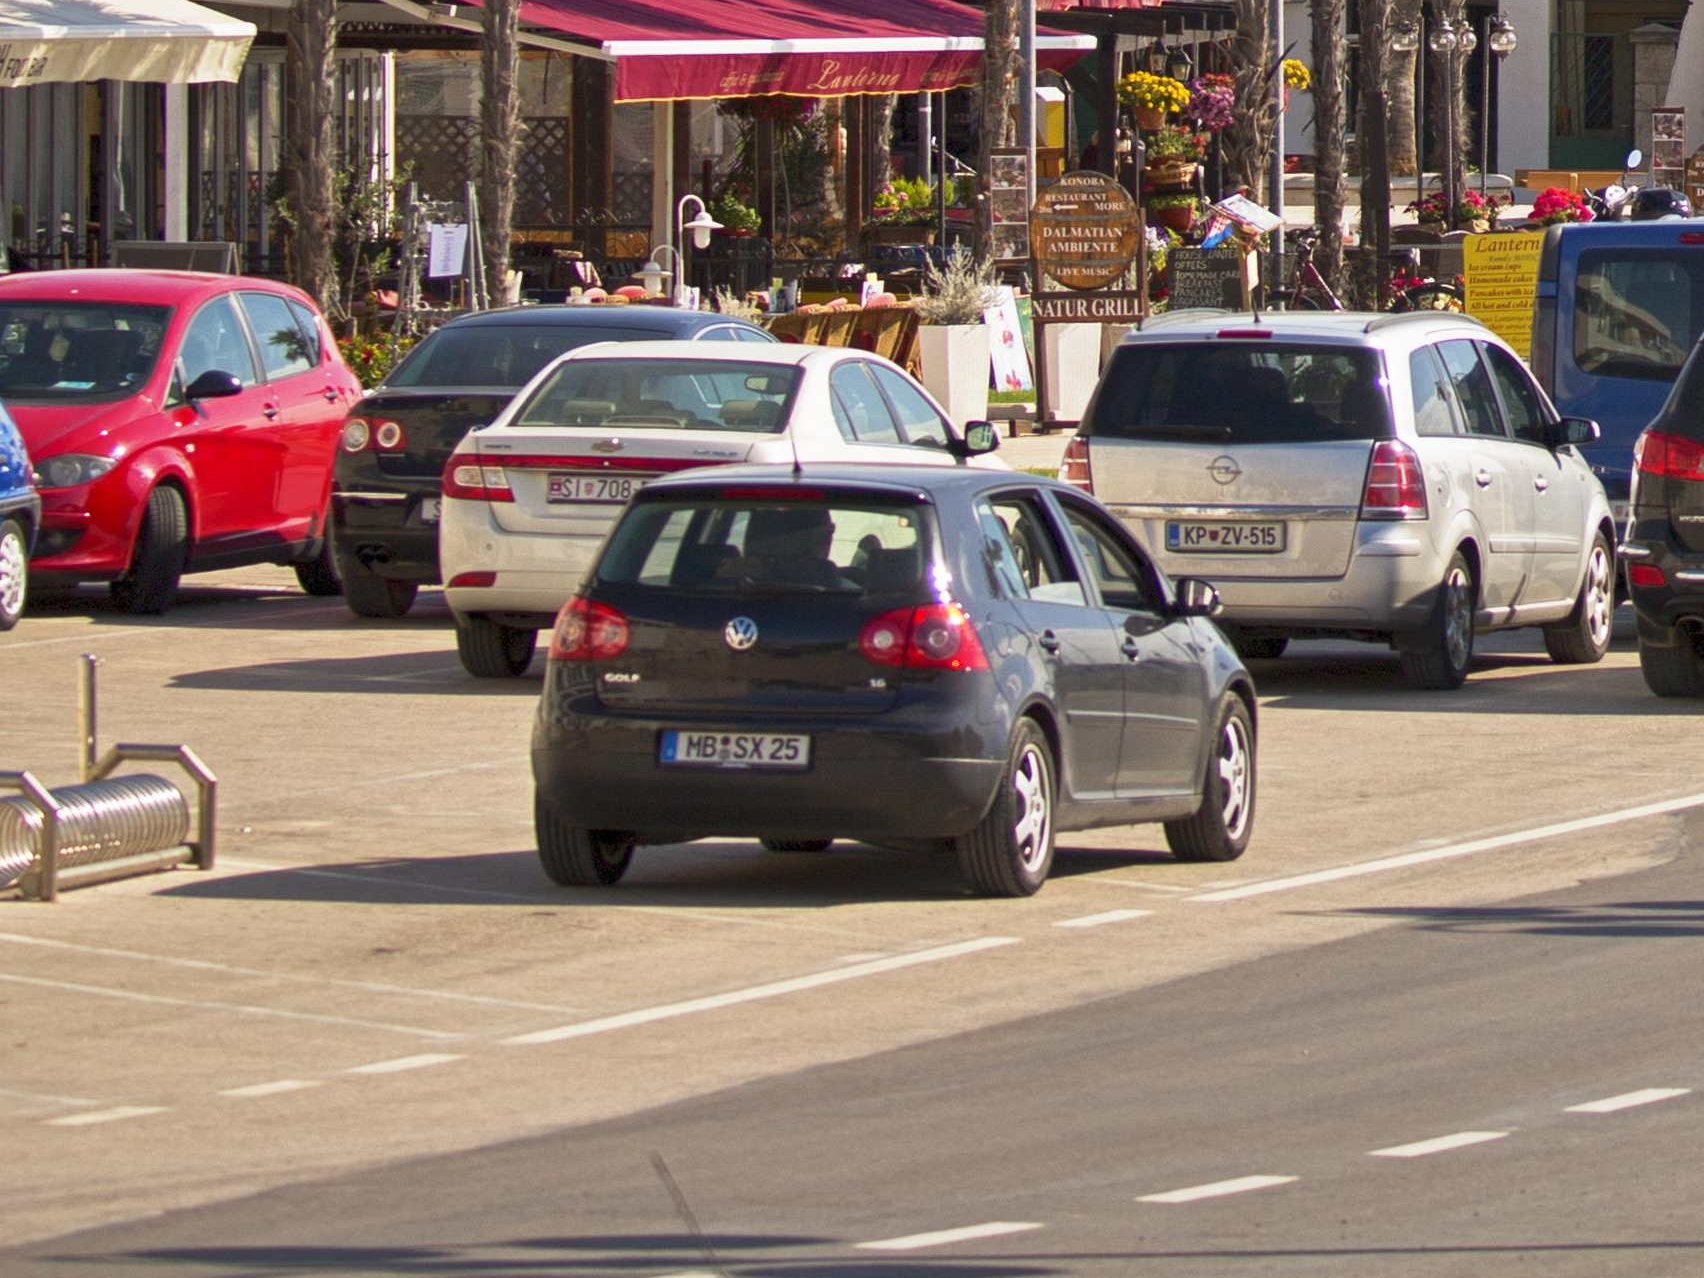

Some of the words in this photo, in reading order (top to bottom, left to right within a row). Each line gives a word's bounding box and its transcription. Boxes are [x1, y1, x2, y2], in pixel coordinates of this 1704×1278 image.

[1060, 176, 1106, 187] KONOBA
[1045, 193, 1107, 202] RESTAURANT
[1094, 202, 1126, 211] MORE
[1043, 227, 1123, 238] DALMATIAN
[1048, 242, 1118, 253] AMBIENTE
[1475, 237, 1540, 253] Lantern
[1207, 249, 1239, 260] LANTE
[1057, 267, 1080, 276] LIVE
[1082, 267, 1110, 276] MUSIC
[1469, 276, 1511, 284] Homemade
[1513, 275, 1533, 283] cakes
[1033, 299, 1088, 317] NATUR
[1092, 298, 1144, 317] GRILL
[1184, 526, 1207, 545] KP
[1221, 526, 1276, 546] ZV-515
[604, 673, 640, 683] GOLF
[685, 735, 717, 758] MB
[733, 736, 764, 760] SX
[769, 738, 800, 761] 25
